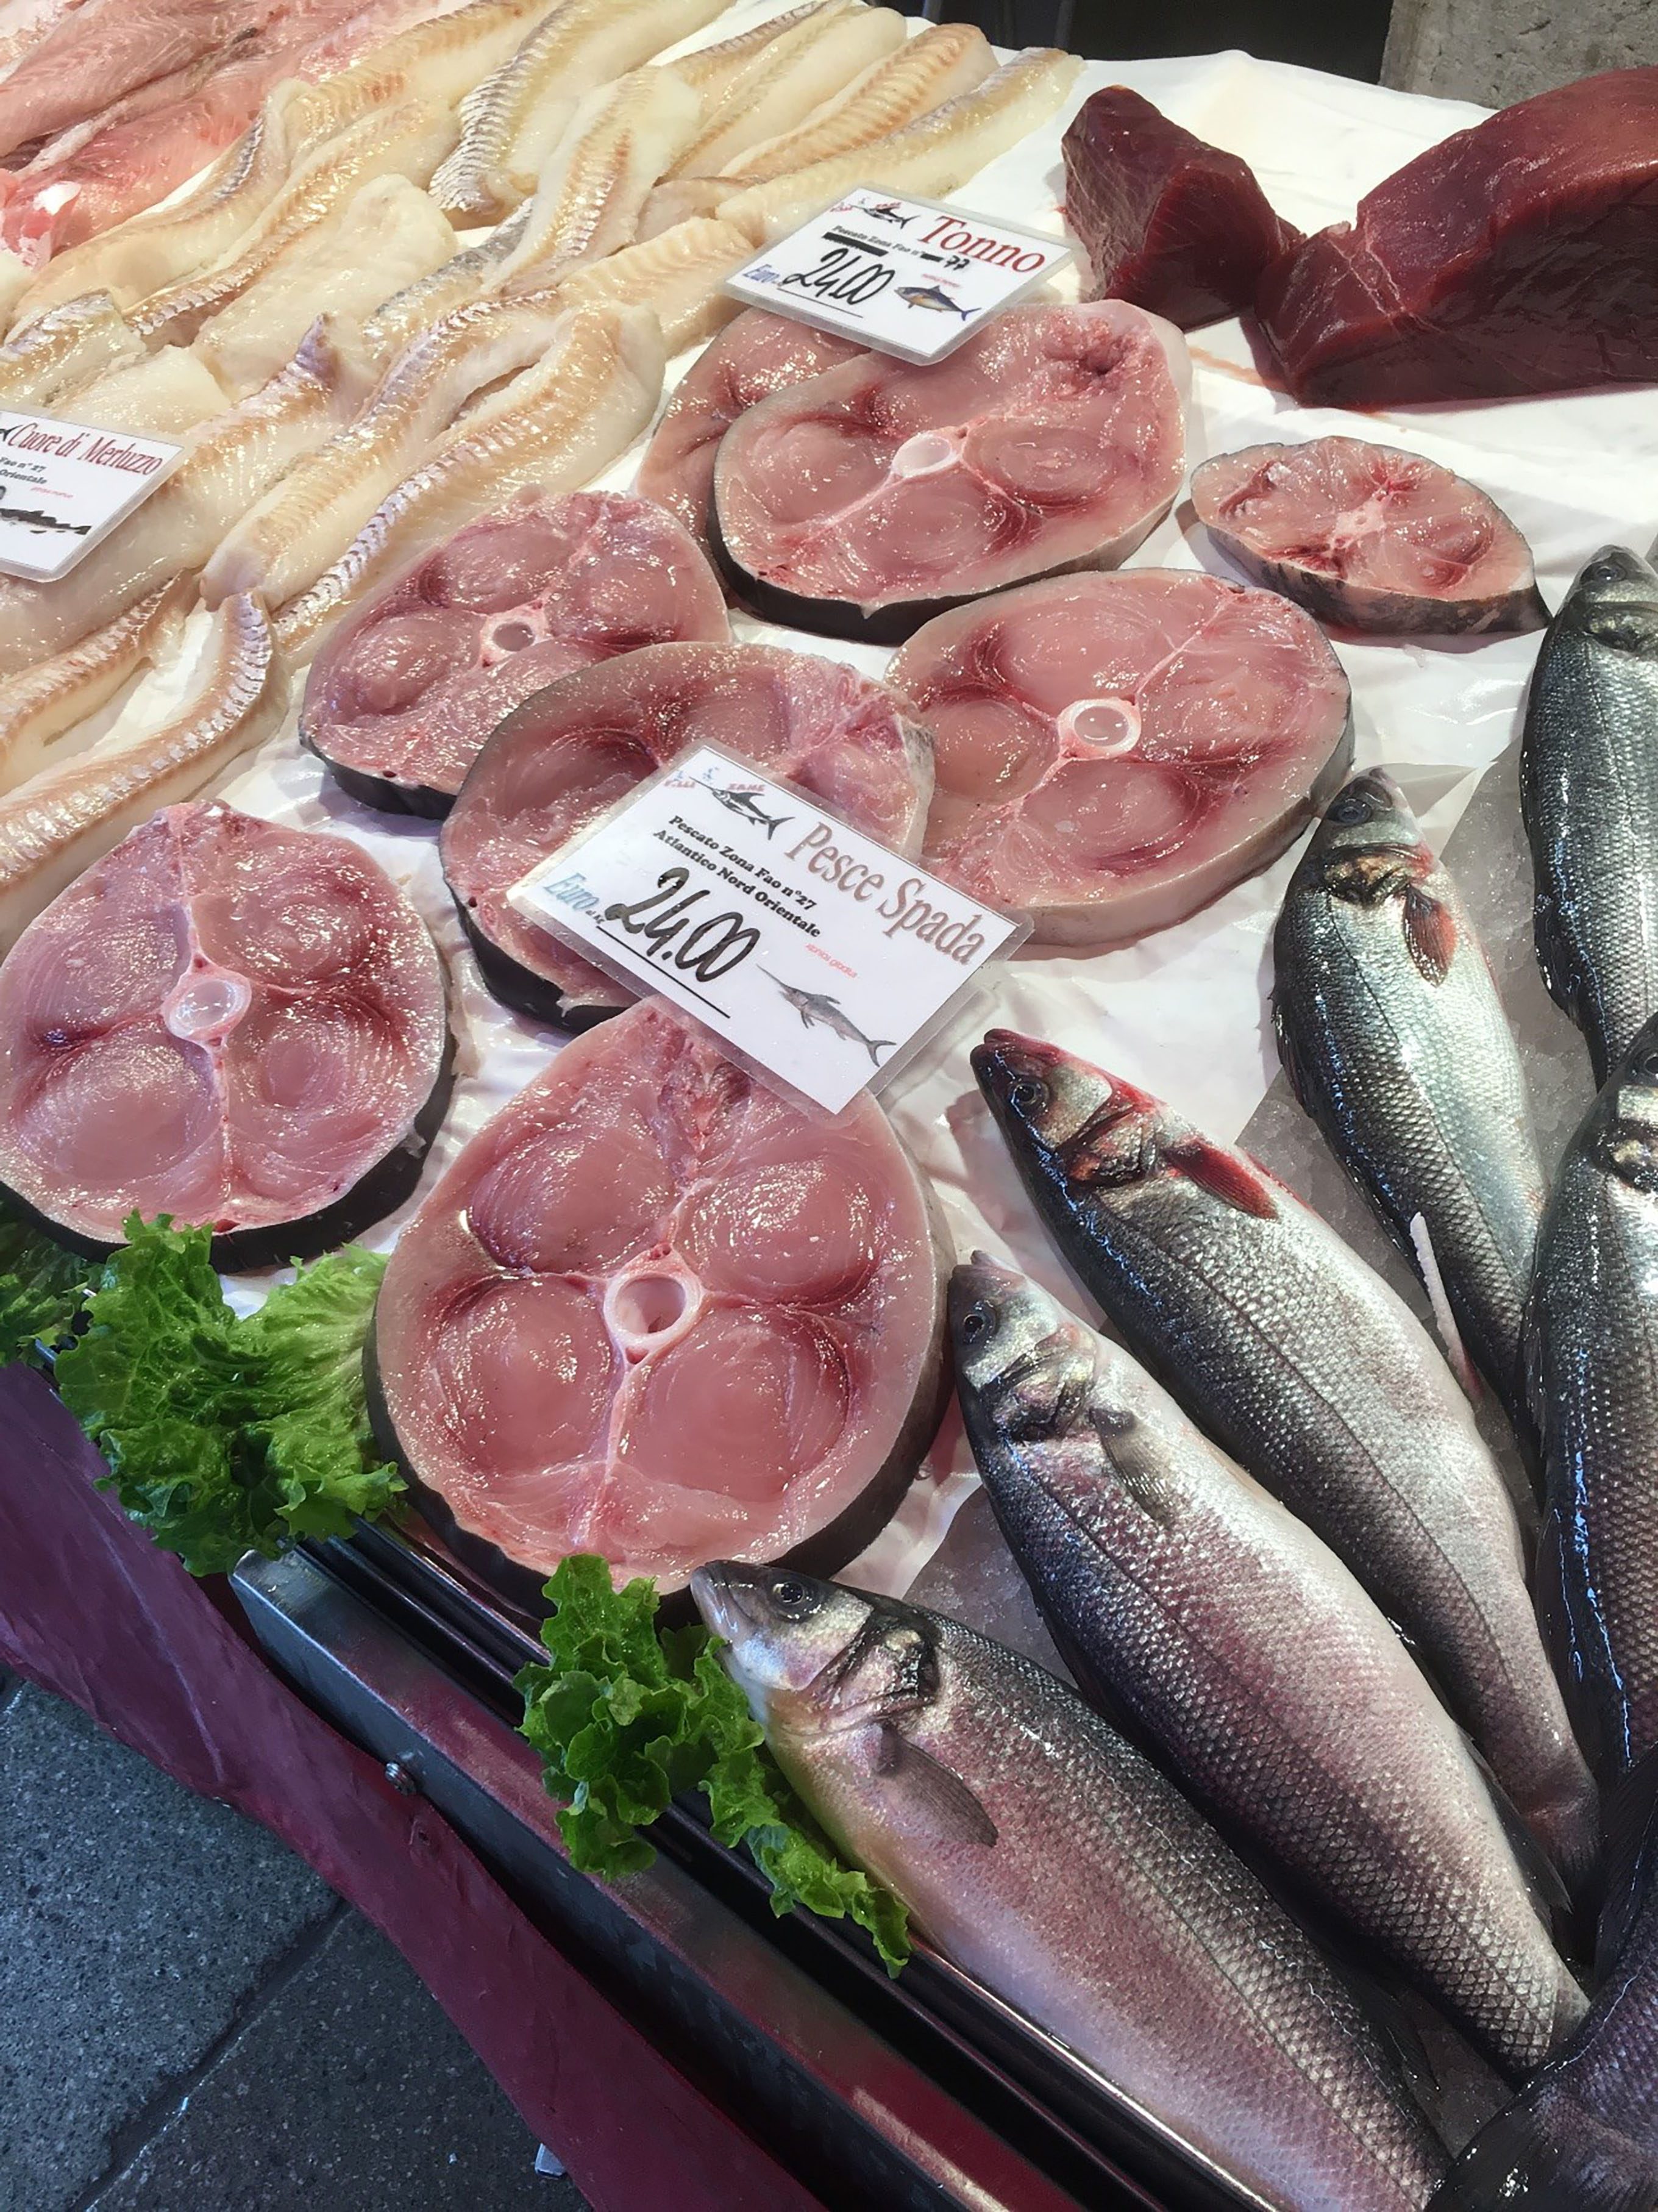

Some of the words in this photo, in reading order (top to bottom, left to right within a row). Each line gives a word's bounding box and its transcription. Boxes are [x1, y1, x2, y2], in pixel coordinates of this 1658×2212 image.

[832, 225, 868, 240] Pescato
[867, 235, 892, 247] Zona
[917, 216, 1045, 273] Tonno
[742, 263, 780, 283] Euro
[0, 469, 48, 485] Orientale
[8, 423, 62, 452] Cuore
[54, 432, 90, 457] di
[77, 437, 163, 476] Merluzzo
[669, 815, 719, 850] Pescato
[719, 845, 755, 872] Zona
[754, 867, 782, 889] Fao
[653, 830, 717, 871] Atlantico
[717, 867, 756, 895] Nord
[755, 891, 821, 938] Orientale
[785, 821, 884, 902] Pesce
[875, 877, 985, 965] Spada
[543, 872, 600, 911] Euro
[604, 867, 761, 983] 24.00
